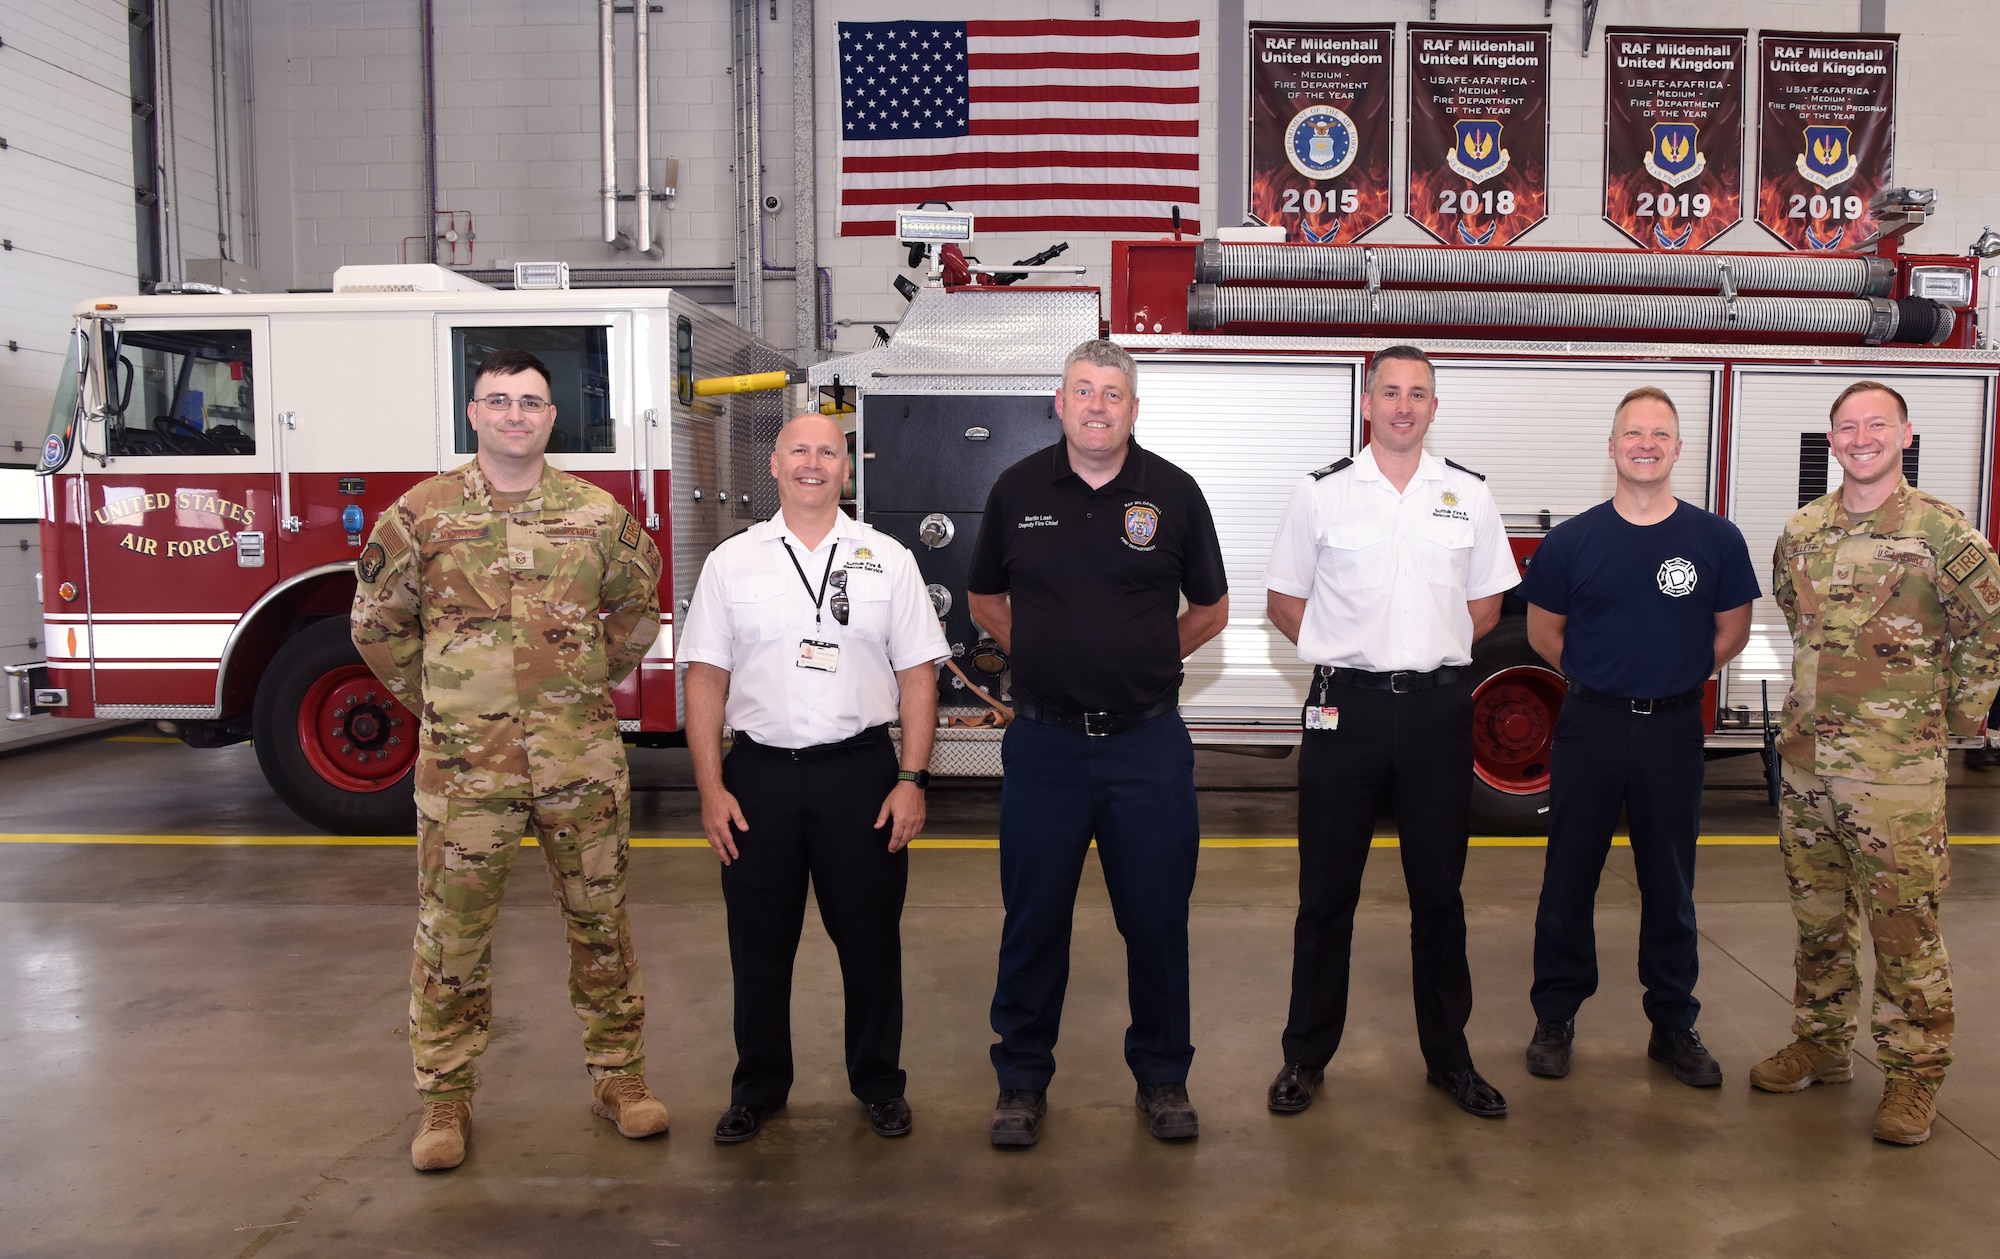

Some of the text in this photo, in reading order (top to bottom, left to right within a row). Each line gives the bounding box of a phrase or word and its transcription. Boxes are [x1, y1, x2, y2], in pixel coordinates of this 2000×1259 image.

[1265, 38, 1378, 50] RAF Mildenhall
[1423, 40, 1535, 52] RAF Mildenhall
[1621, 43, 1731, 57] RAF Mildenhall
[1261, 52, 1383, 67] United Kingdom
[1774, 47, 1883, 61] RAF Mildenhall
[1419, 53, 1539, 69] United Kingdom
[1617, 57, 1735, 73] United Kingdom
[1770, 61, 1887, 77] United Kingdom
[1274, 81, 1369, 90] FIRE DEPARTMENT
[1430, 77, 1528, 86] USAFE-AFAFRICA
[1627, 80, 1724, 89] USAFE-AFAFRICA
[1328, 92, 1355, 100] YEAR
[1458, 87, 1499, 95] MEDIUM
[1656, 90, 1696, 98] MEDIUM
[1786, 86, 1870, 95] USAFE-AFAFRICA
[1433, 96, 1525, 105] FIRE DEPARTMENT
[1630, 99, 1721, 109] FIRE DEPARTMENT
[1485, 107, 1511, 115] YEAR
[1682, 110, 1707, 118] YEAR
[1768, 102, 1887, 113] FIRE PREVENTION PROGRAM
[1282, 189, 1358, 213] 2015
[1439, 190, 1515, 215] 2018
[1636, 193, 1711, 217] 2019
[1789, 195, 1862, 219] 2019
[94, 492, 256, 526] UNITED STATES
[623, 519, 639, 545] FIRE
[120, 531, 234, 558] AIR FORCE
[1949, 548, 1981, 579] FIRE
